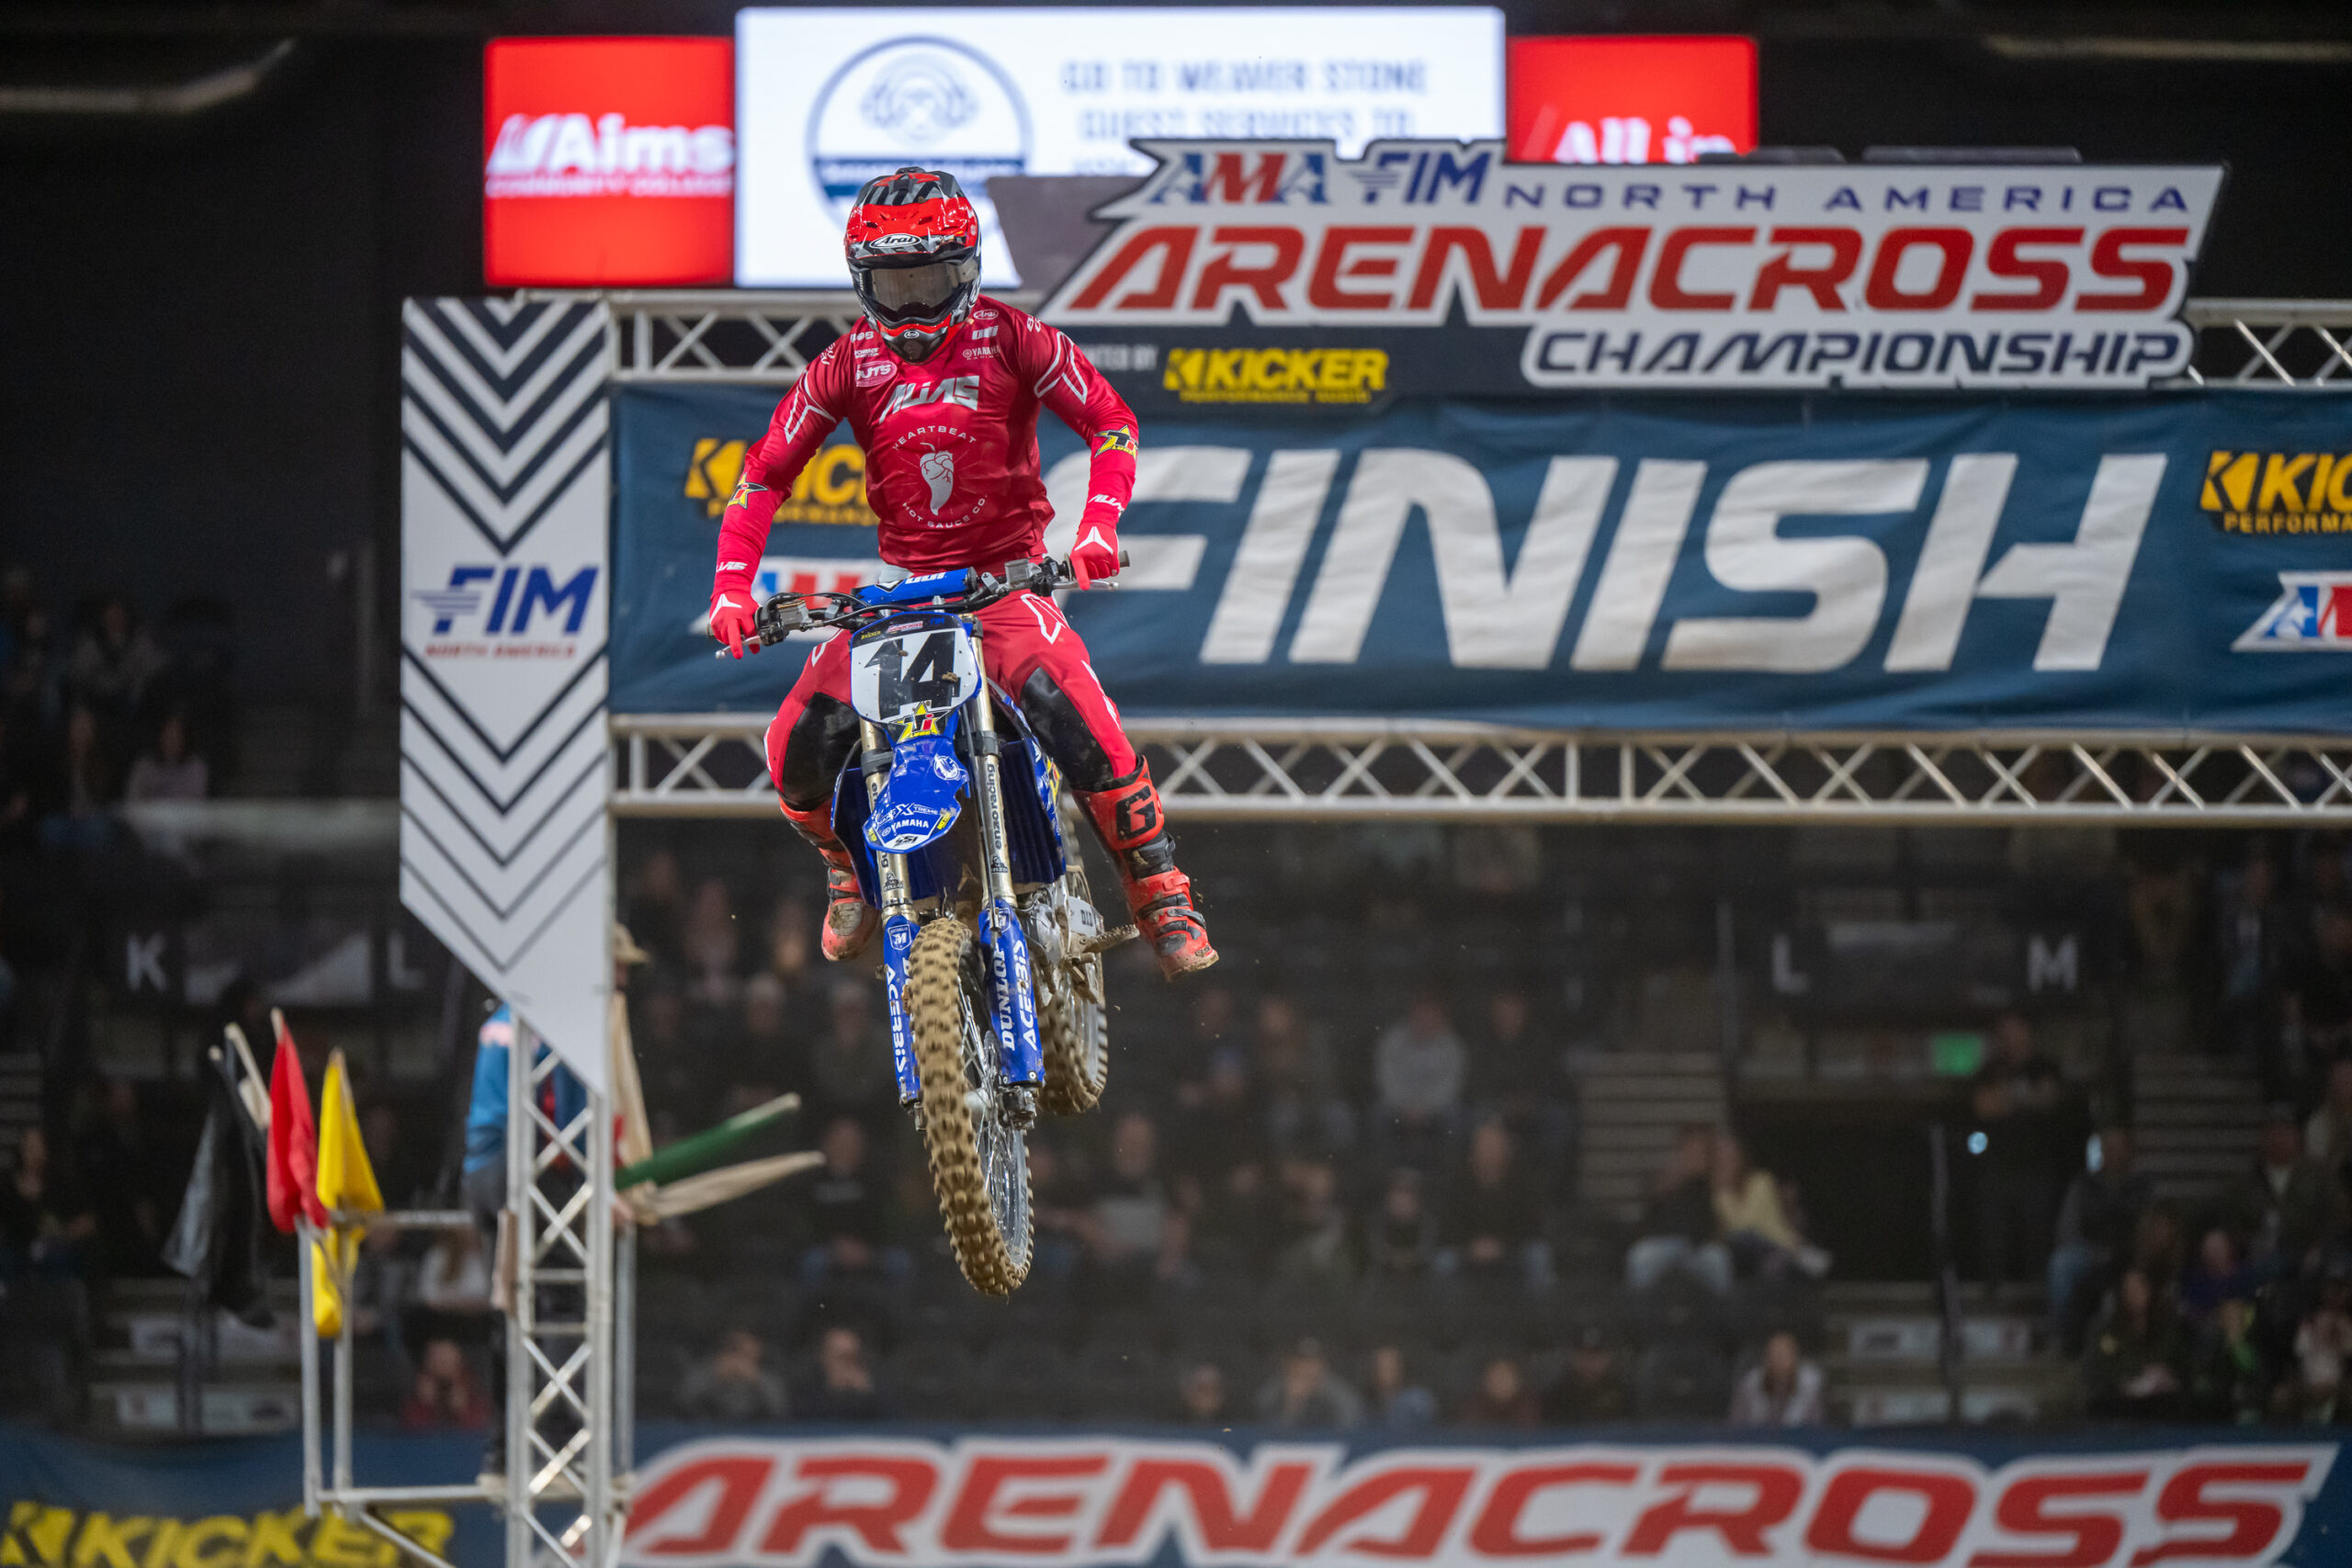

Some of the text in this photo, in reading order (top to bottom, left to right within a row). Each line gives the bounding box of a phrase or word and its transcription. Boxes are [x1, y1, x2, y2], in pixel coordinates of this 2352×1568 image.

[549, 113, 733, 175] Aims
[1148, 152, 1330, 204] AMA
[1347, 152, 1493, 204] FIM
[1504, 184, 1777, 210] NORTH
[1824, 187, 2190, 212] AMERICA
[878, 235, 915, 246] Arai
[1069, 226, 2190, 312] ARENACROSS
[1204, 348, 1389, 390] KICKER
[1534, 333, 2188, 376] CHAMPIONSHIP
[892, 425, 977, 451] HEARTBEAT
[902, 502, 924, 522] HOT
[927, 515, 971, 529] SAUCE
[1044, 447, 2168, 672] FINISH
[412, 567, 599, 634] FIM
[865, 631, 960, 720] 14
[891, 818, 929, 833] YAMAHA
[126, 931, 167, 992] K
[1770, 933, 1811, 994] L
[2027, 933, 2079, 993] M
[886, 963, 907, 1073] ACERBIS
[993, 942, 1015, 1052] DUNLOP
[1012, 940, 1037, 1052] ACERBIS
[64, 1503, 453, 1568] KICKER
[571, 1454, 2313, 1568] ARENACROSS
